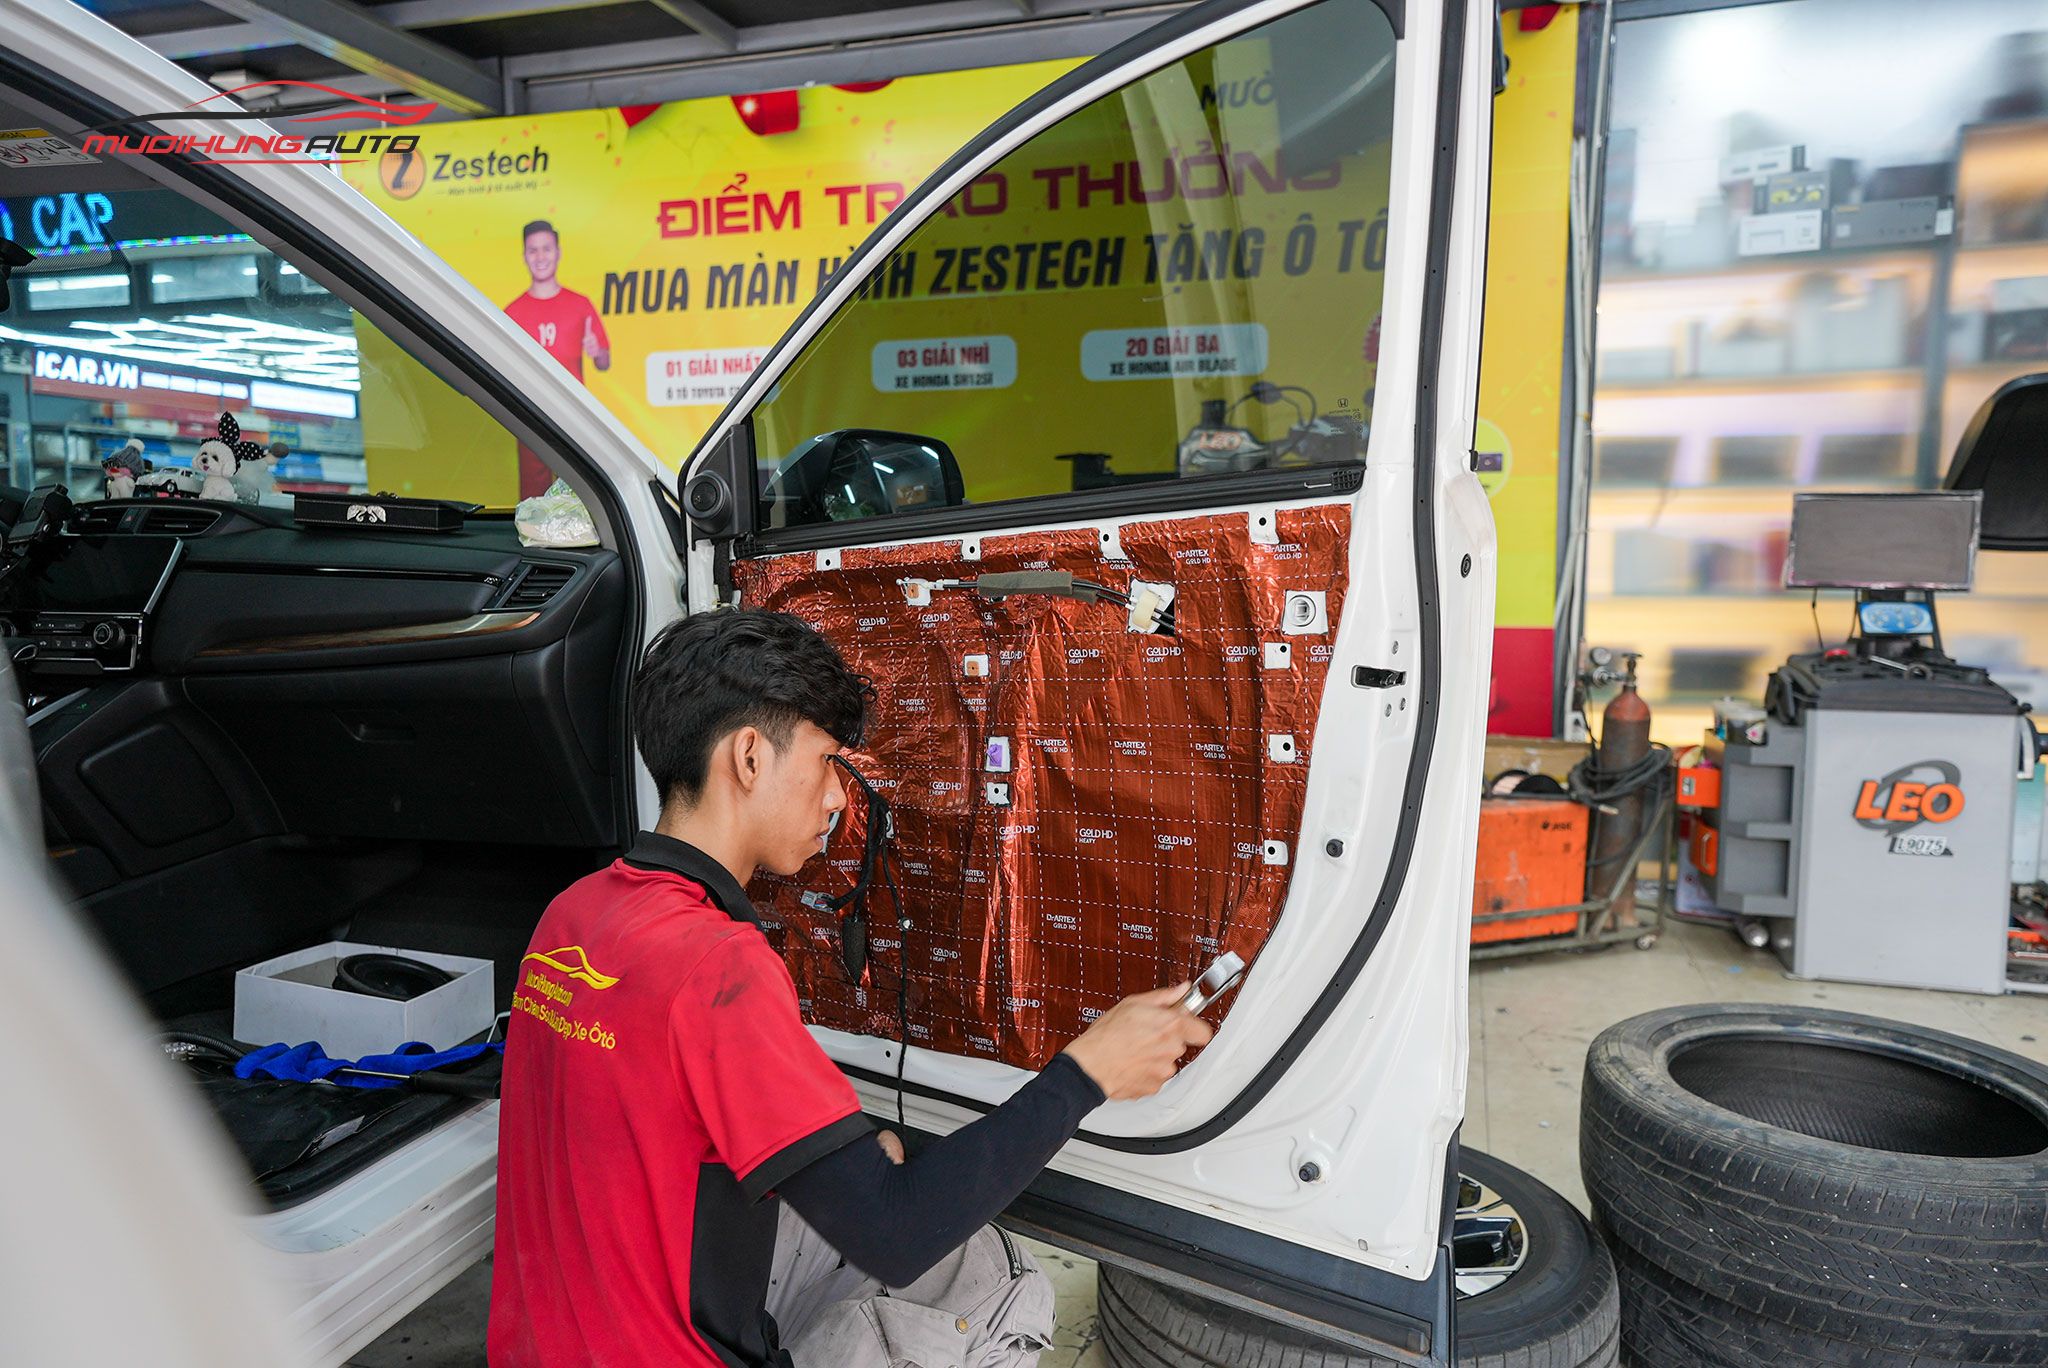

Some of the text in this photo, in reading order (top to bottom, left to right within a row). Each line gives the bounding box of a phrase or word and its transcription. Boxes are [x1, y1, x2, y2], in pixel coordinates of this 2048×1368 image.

[433, 146, 549, 181] Zestech
[656, 173, 801, 240] ĐIỂM
[825, 172, 1008, 226] TRO
[602, 268, 689, 316] MUA
[706, 253, 800, 310] MÀN
[930, 236, 1125, 296] ZESTECH
[1144, 223, 1266, 294] TẶNG
[1283, 213, 1317, 277] Ô
[538, 323, 556, 346] 19
[1126, 329, 1220, 358] 20 GIẢI BA
[897, 349, 918, 368] 03
[922, 341, 956, 367] GIẢI
[35, 350, 140, 390] ICAR.VN
[666, 360, 682, 378] 01
[688, 352, 718, 377] GIẢI
[1129, 360, 1171, 375] HONDA
[858, 617, 876, 627] GOLD
[922, 614, 939, 623] GOLD
[1068, 649, 1100, 658] GOLD HD
[1146, 647, 1182, 657] GOLD HD
[1226, 645, 1248, 656] GOLD
[1035, 739, 1068, 747] DrARTEX
[1114, 741, 1146, 749] DrARTEX
[885, 779, 897, 788] HD
[932, 781, 962, 791] GOLD HD
[1852, 780, 1966, 824] LEO
[1023, 825, 1036, 834] HD
[1080, 828, 1113, 839] GOLD HD
[1157, 834, 1193, 846] GOLD HD
[1046, 913, 1076, 924] DrARTEX
[1053, 922, 1068, 930] GOLD
[1122, 922, 1153, 934] DrARTEX
[1129, 931, 1144, 940] GOLD
[873, 938, 902, 949] GOLD HD
[933, 947, 949, 957] GOLD
[1006, 996, 1040, 1009] GOLD HD
[571, 1020, 588, 1041] Xe
[588, 1021, 616, 1050] Ôtô
